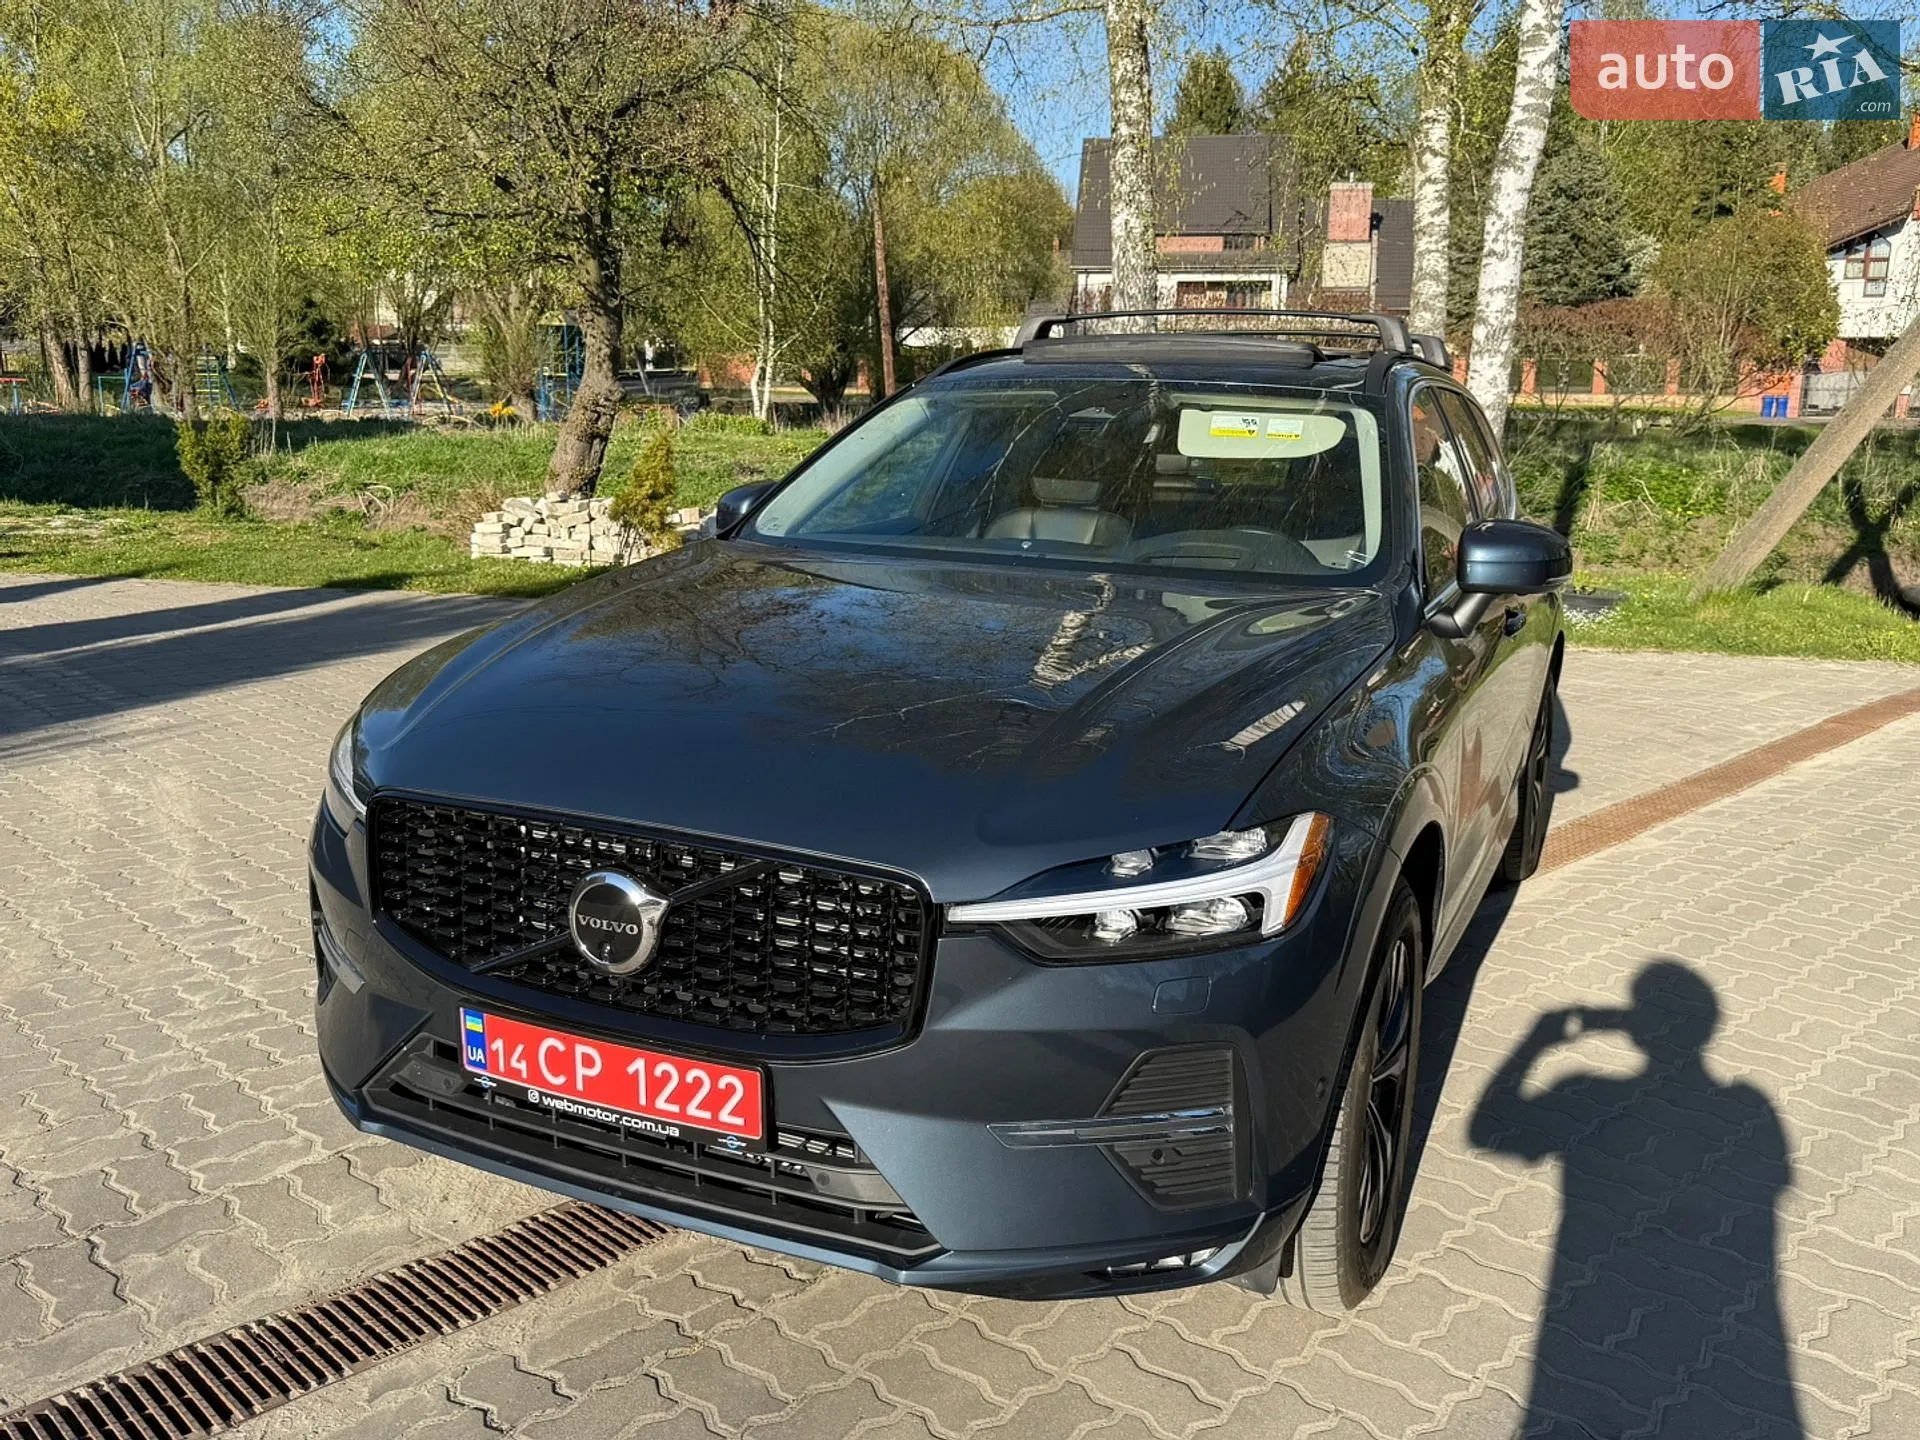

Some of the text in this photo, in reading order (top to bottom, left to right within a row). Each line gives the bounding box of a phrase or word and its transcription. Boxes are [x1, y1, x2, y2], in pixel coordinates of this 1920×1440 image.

[577, 914, 638, 935] VOLVO
[468, 1045, 485, 1064] UA
[490, 1037, 745, 1126] 14 CP 1222
[542, 1094, 680, 1136] webmotor.com.ua
